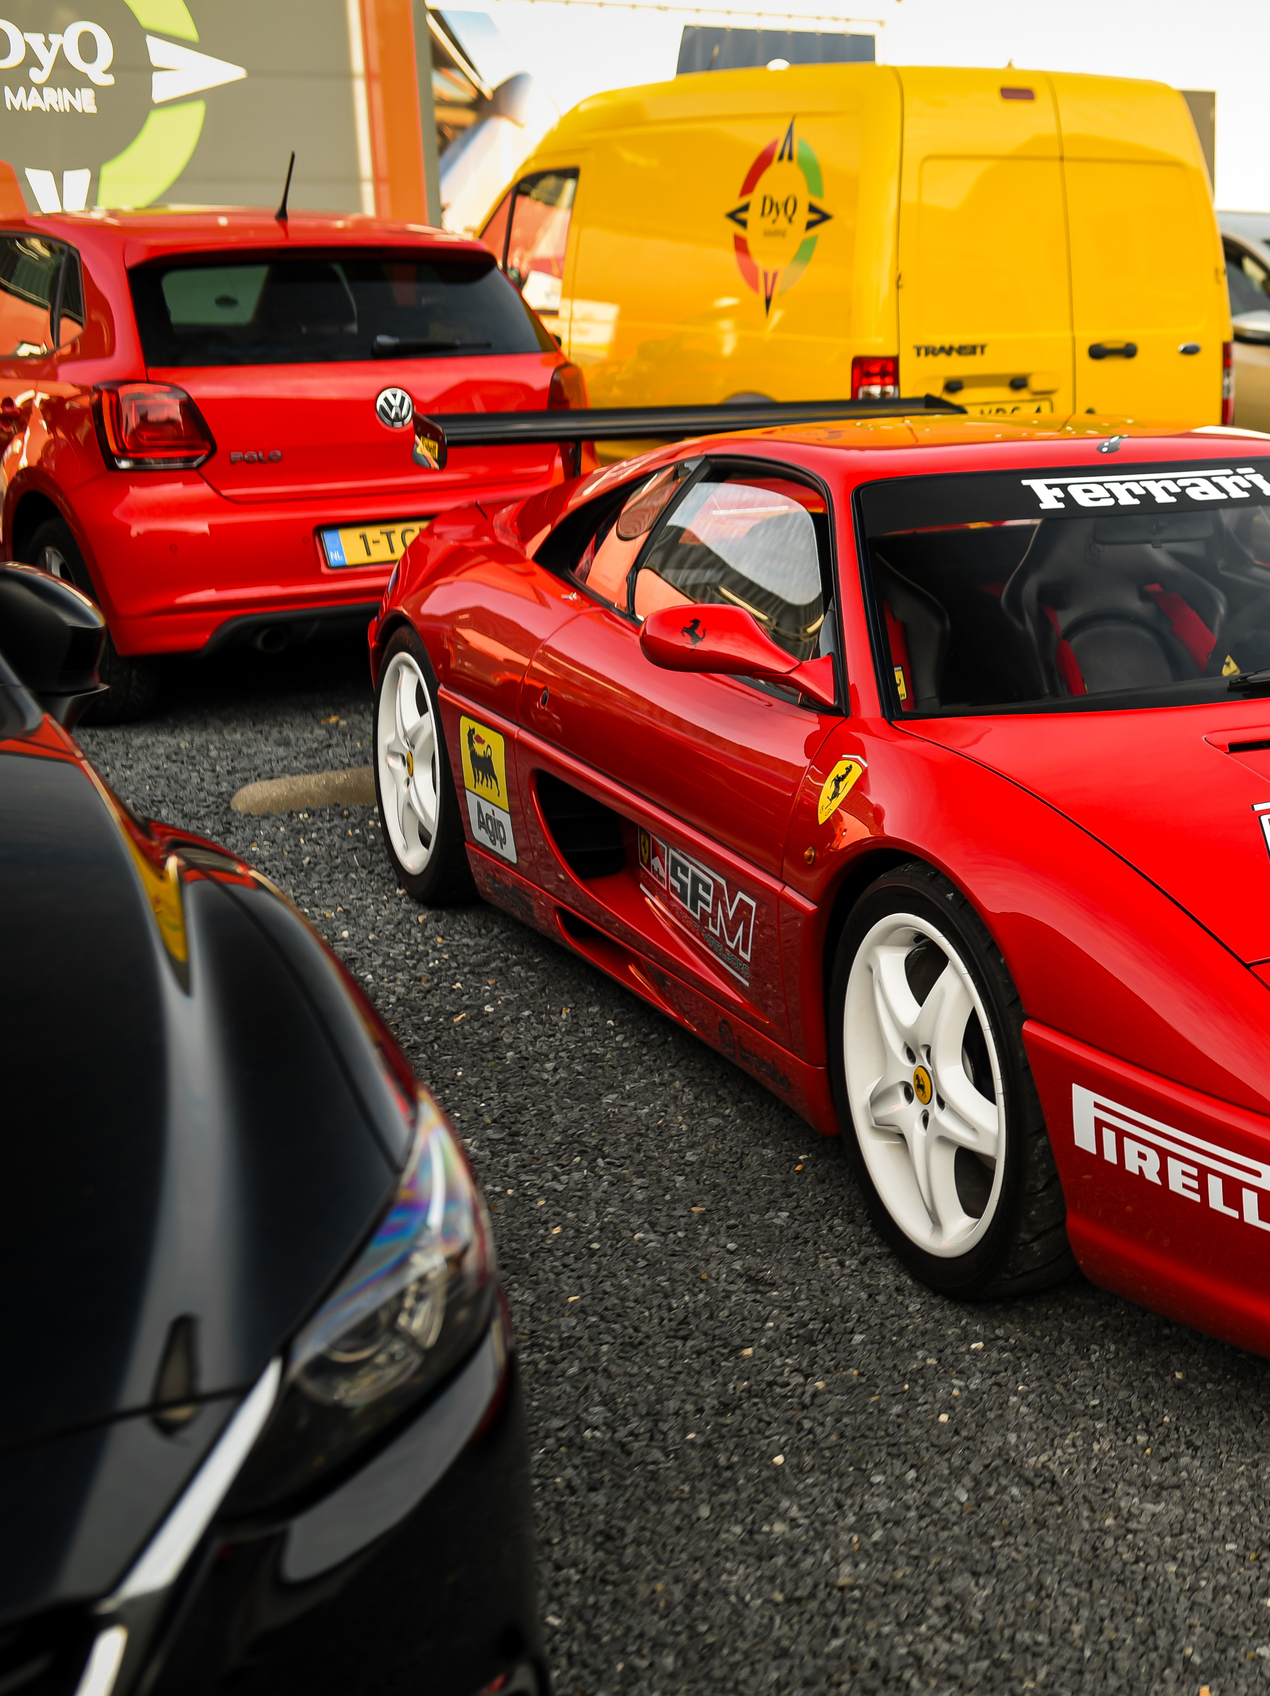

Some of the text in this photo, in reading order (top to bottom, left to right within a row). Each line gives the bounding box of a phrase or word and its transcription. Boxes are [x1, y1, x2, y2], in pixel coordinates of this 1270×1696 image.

[4, 85, 97, 113] MARINE
[761, 193, 798, 225] DyQ
[913, 343, 988, 358] TRANSIT
[230, 449, 282, 464] POLO
[330, 550, 343, 562] NL
[476, 800, 507, 851] Agip
